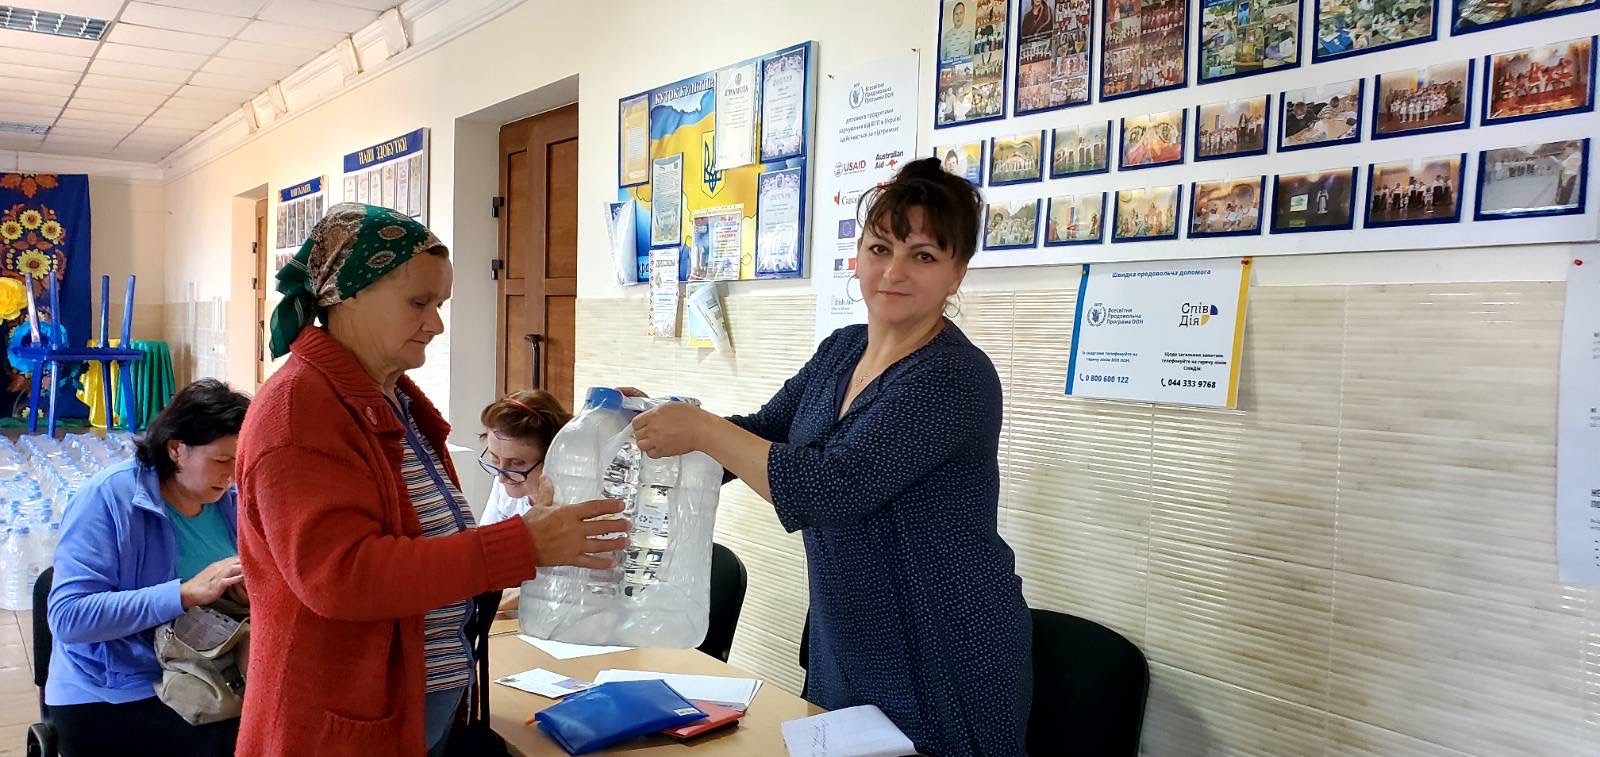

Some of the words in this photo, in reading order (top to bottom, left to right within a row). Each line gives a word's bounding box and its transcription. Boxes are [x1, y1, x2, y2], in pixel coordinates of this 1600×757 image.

[875, 150, 904, 160] Australian
[844, 160, 867, 171] USAID
[874, 161, 885, 169] Aid
[1137, 270, 1178, 279] продовольча
[1181, 302, 1209, 314] Спів
[1179, 315, 1199, 327] Дія
[1091, 374, 1102, 382] 800
[1103, 375, 1115, 383] 600
[1117, 376, 1129, 384] 122
[1182, 379, 1196, 387] 333
[1197, 380, 1216, 388] 9768
